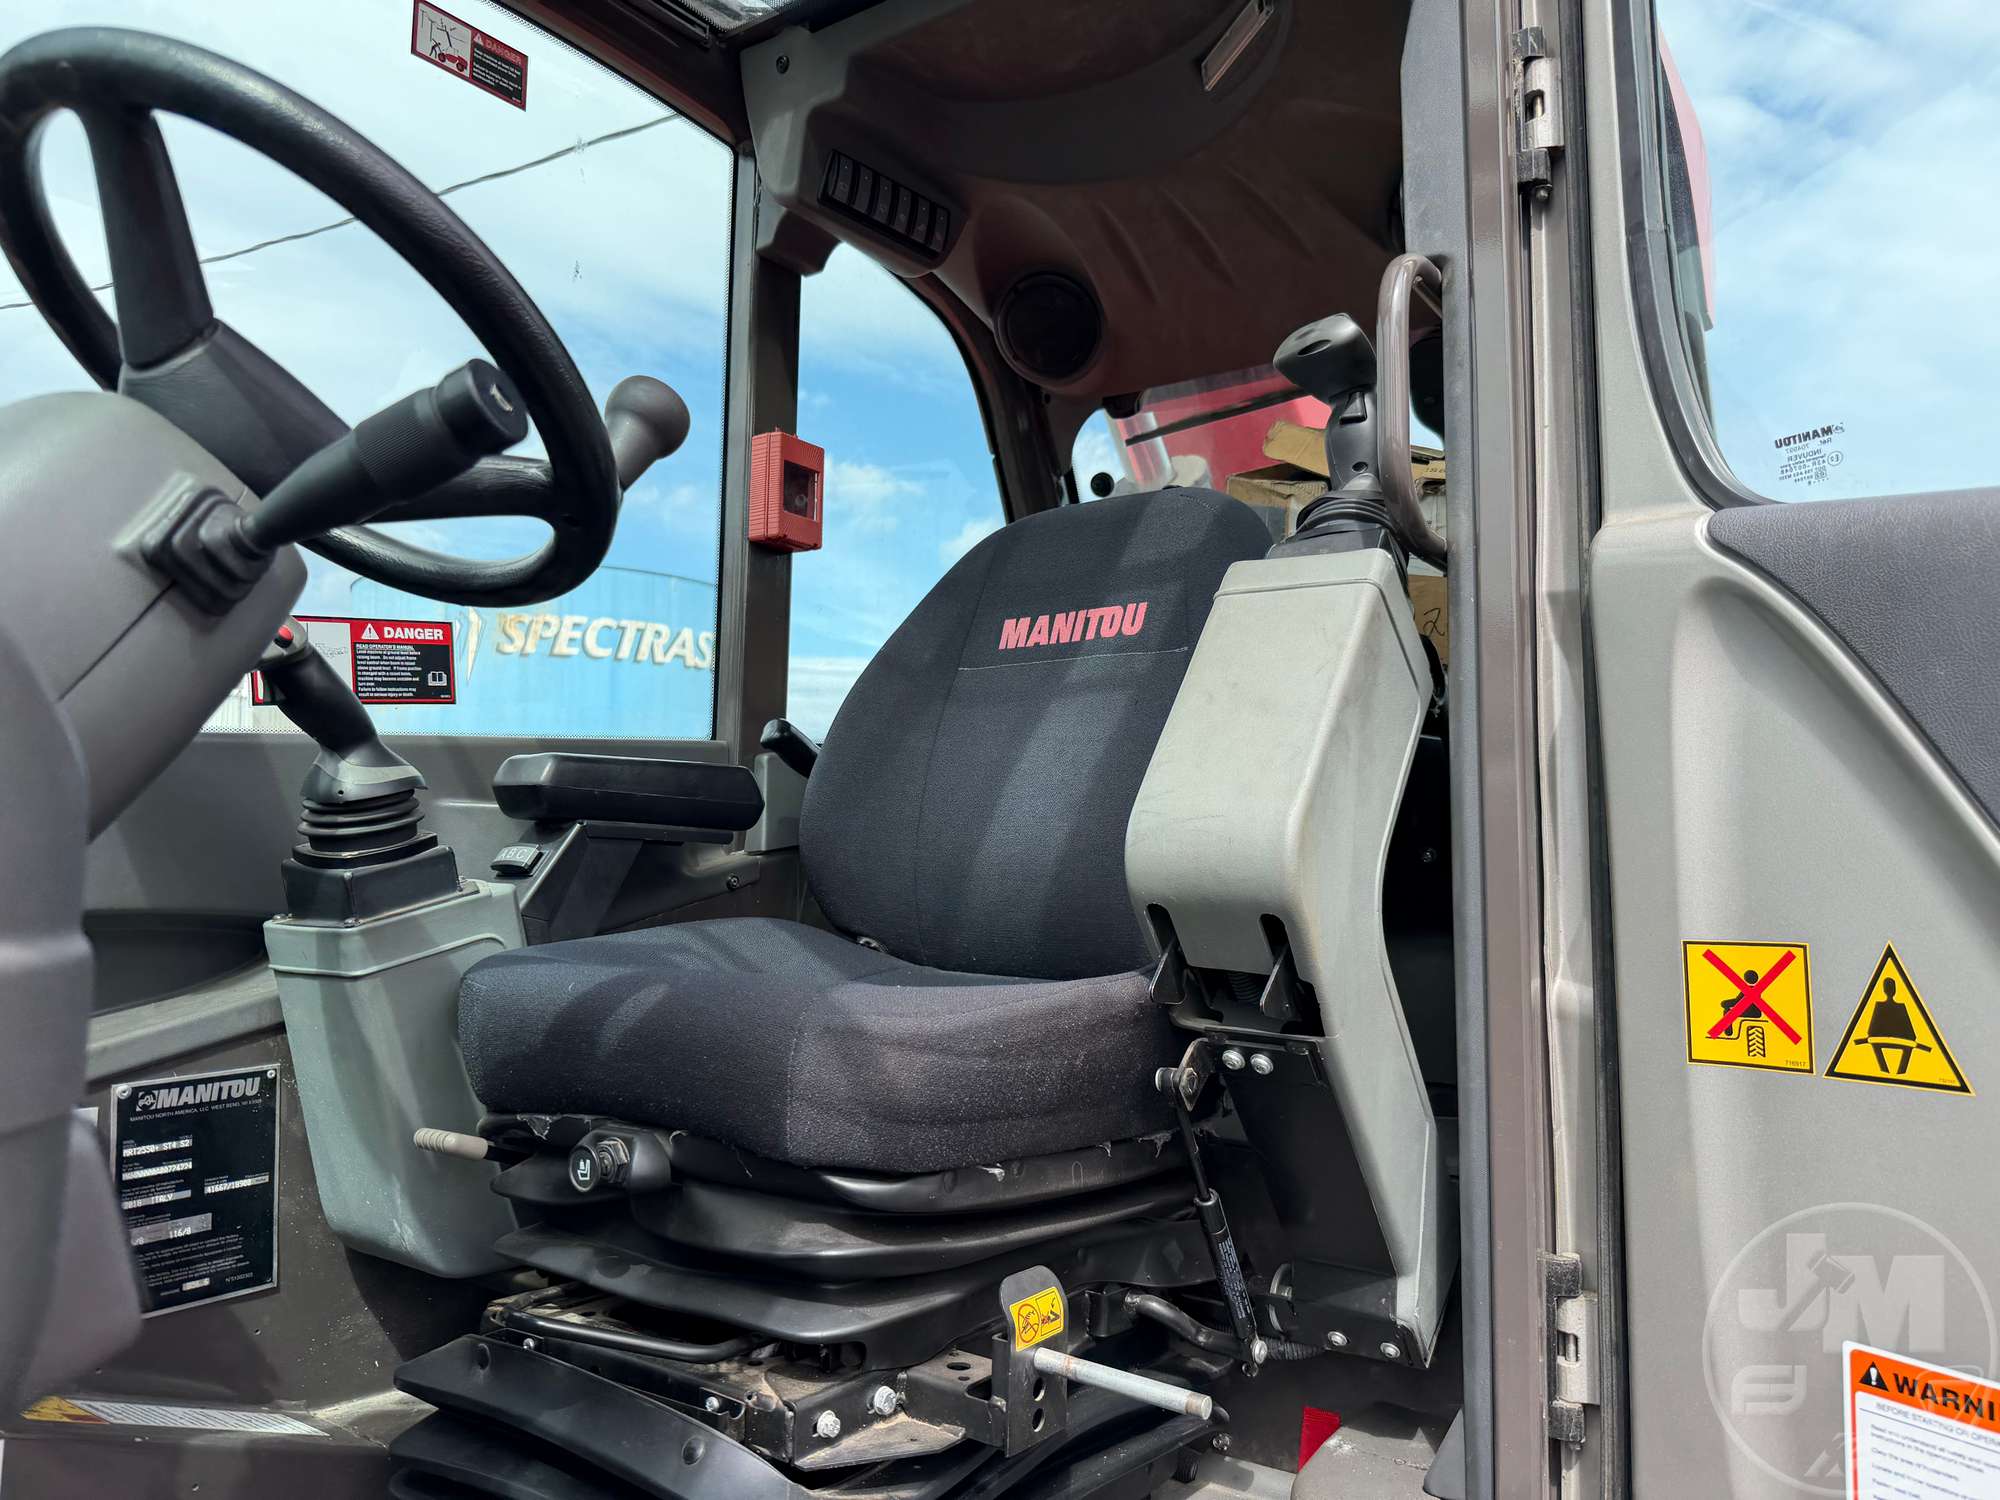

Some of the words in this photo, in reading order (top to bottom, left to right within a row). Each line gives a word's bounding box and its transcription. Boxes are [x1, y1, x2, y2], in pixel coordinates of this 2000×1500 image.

[383, 626, 444, 640] DANGER
[998, 601, 1148, 650] MANITOU
[496, 612, 715, 671] SPECTRAS
[157, 1076, 261, 1109] MANITOU
[155, 1110, 174, 1119] NORTH
[151, 1193, 173, 1204] ITALY
[1876, 1402, 1909, 1419] BEFORE
[1912, 1412, 1954, 1433] STARTING
